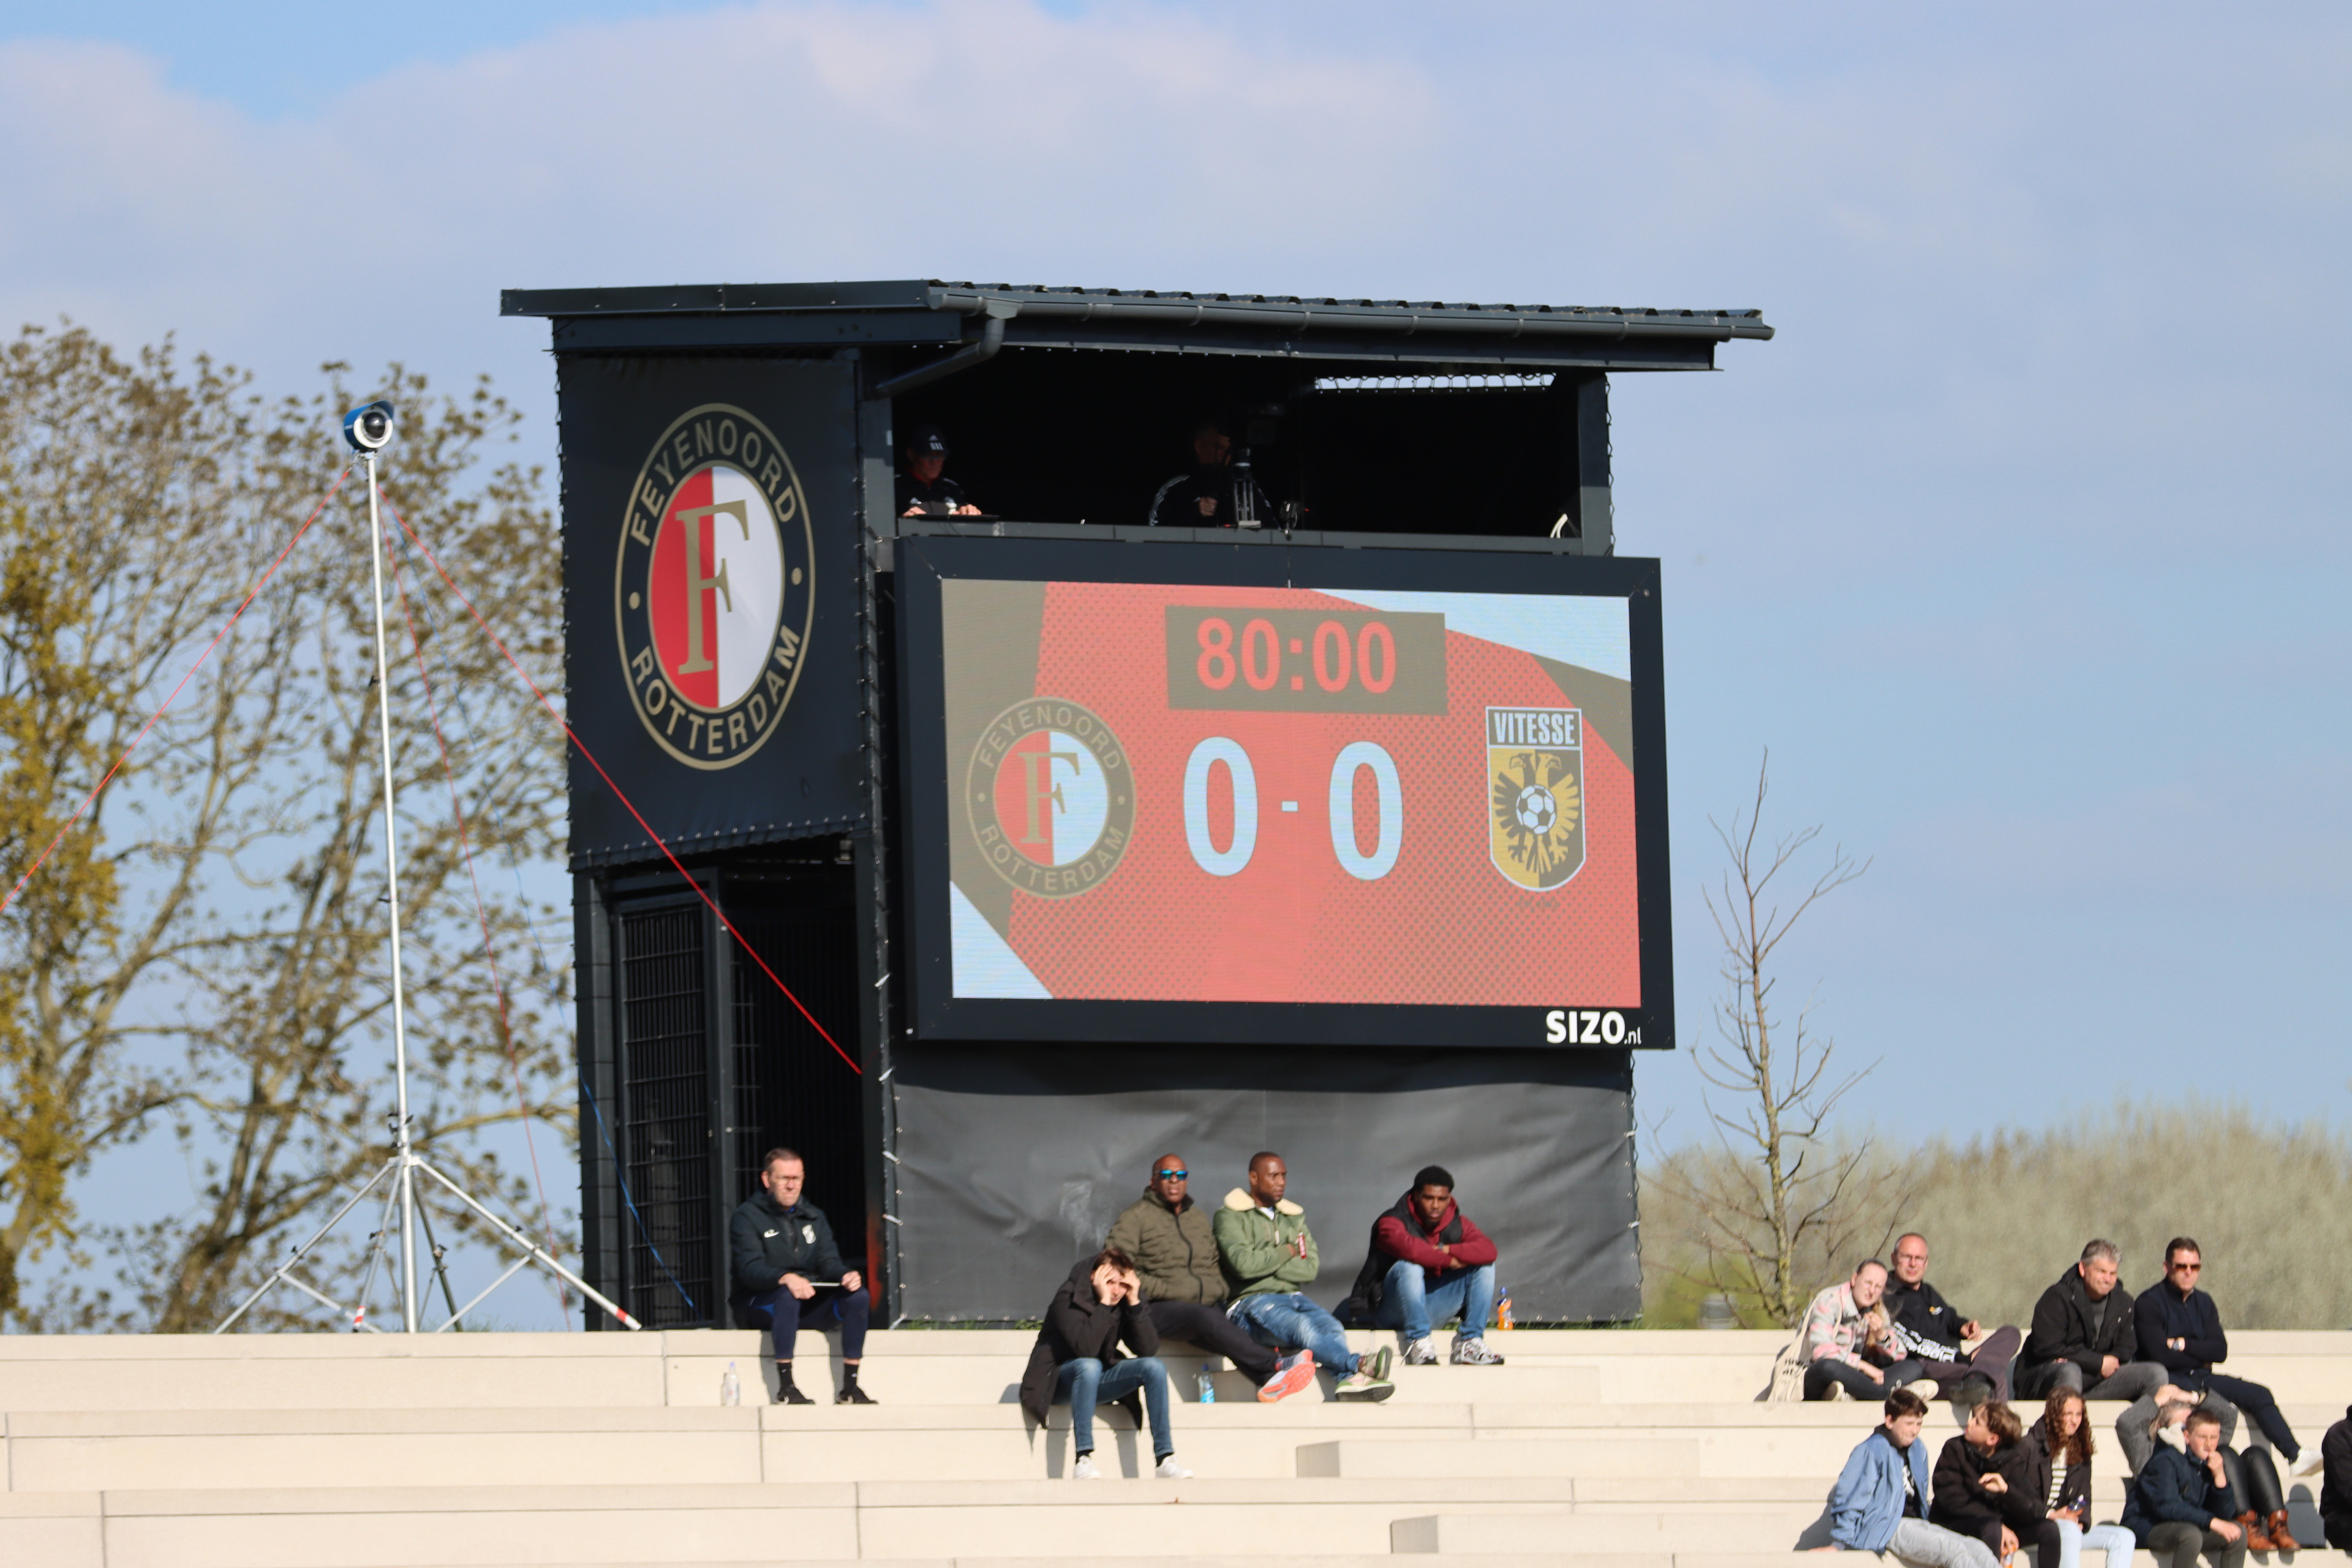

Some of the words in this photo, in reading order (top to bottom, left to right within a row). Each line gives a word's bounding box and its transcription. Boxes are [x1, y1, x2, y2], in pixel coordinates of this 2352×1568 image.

[630, 419, 796, 546] FEYENOORD
[676, 499, 750, 675] F
[631, 624, 800, 755] ROTTERDAM
[1196, 617, 1397, 694] 80:00
[980, 705, 1121, 769] FEYENOORD
[1493, 712, 1575, 745] VITESSE
[1017, 752, 1081, 844] F
[1183, 736, 1259, 877] 0
[1329, 741, 1404, 881] 0
[981, 826, 1125, 891] ROTTERDAM
[1545, 1009, 1642, 1045] SIZO.nl
